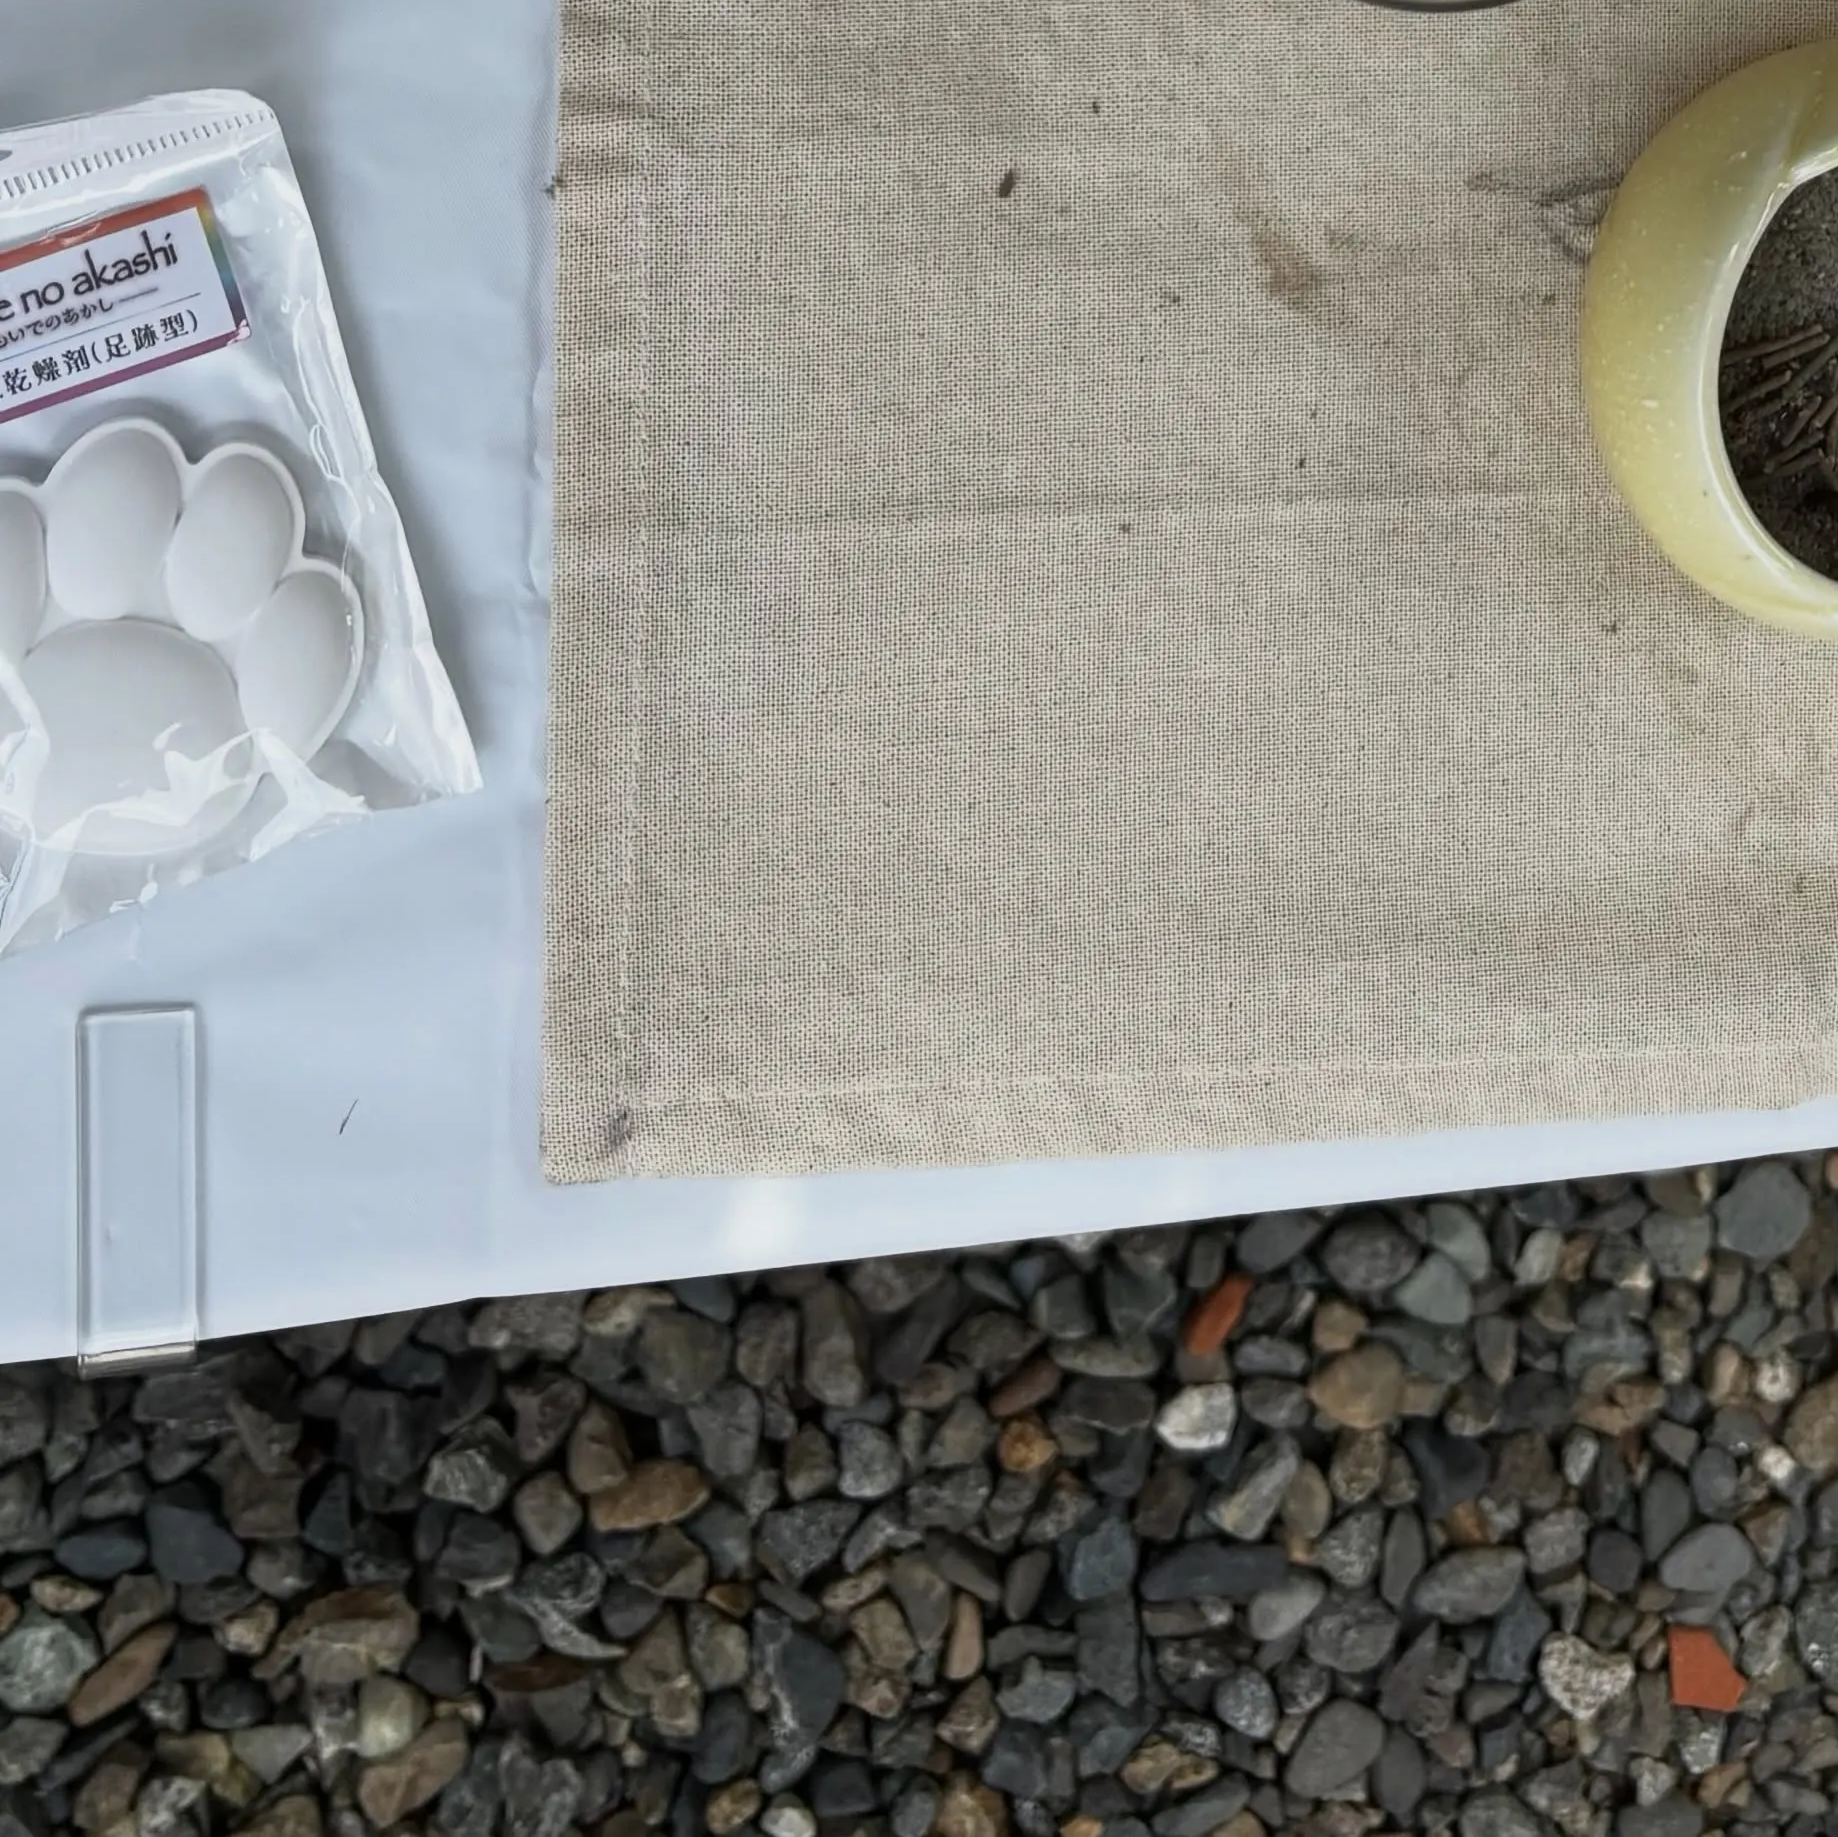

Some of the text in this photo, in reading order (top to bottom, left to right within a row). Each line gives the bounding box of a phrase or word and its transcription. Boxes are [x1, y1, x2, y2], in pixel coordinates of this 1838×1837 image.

[20, 281, 65, 313] no
[72, 230, 178, 295] akashi
[0, 310, 198, 399] 乾燥剤(足跡型)
